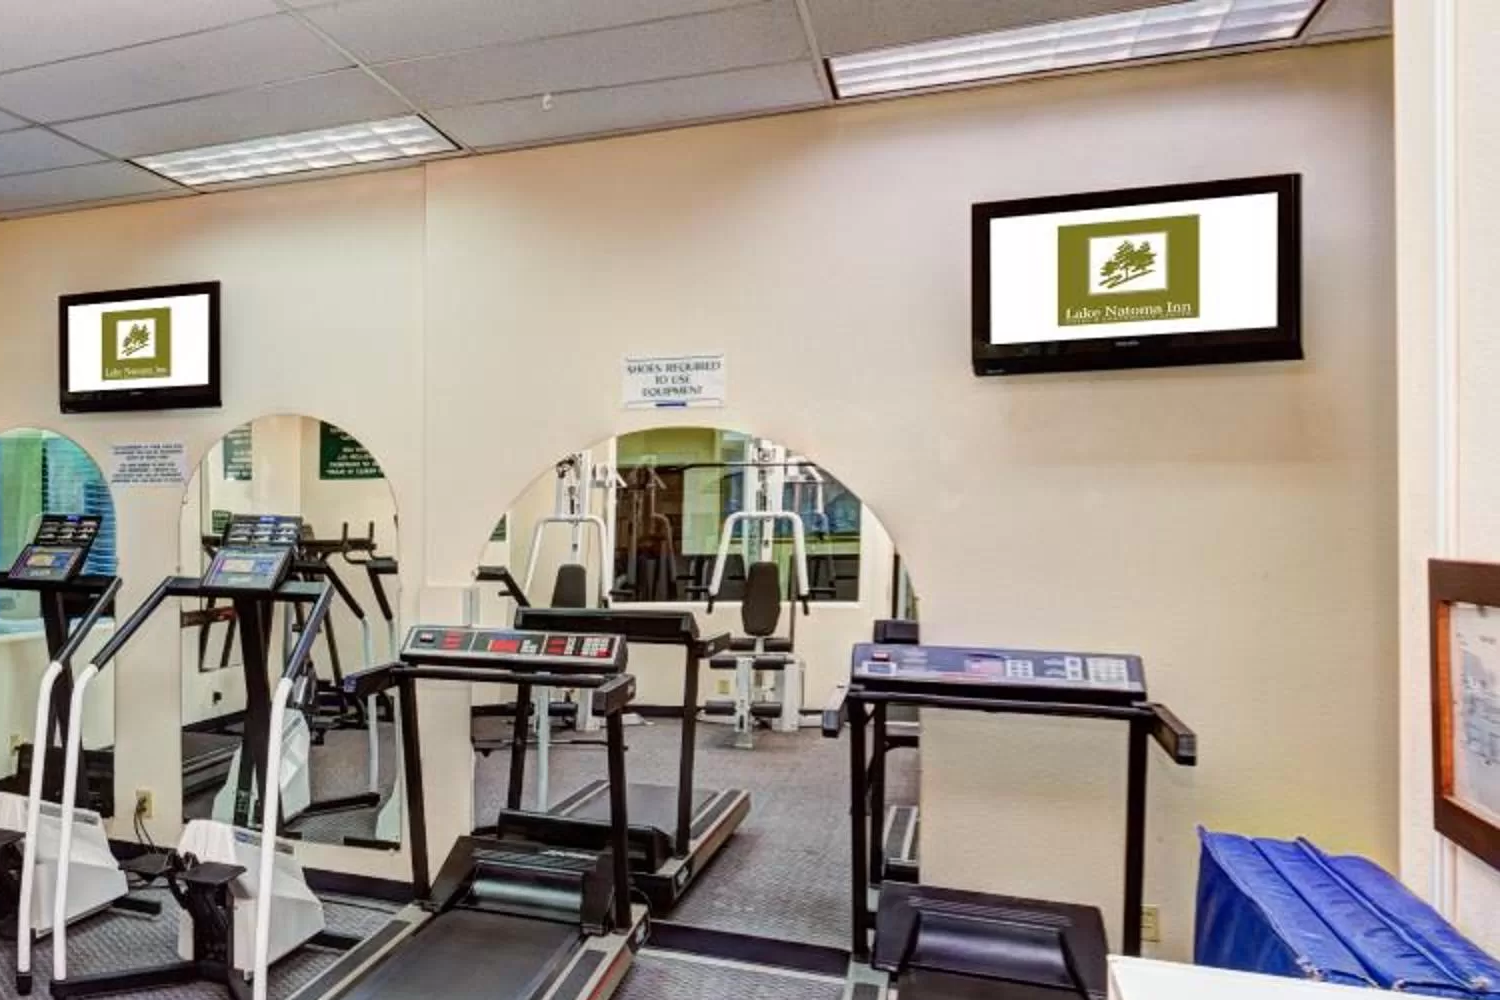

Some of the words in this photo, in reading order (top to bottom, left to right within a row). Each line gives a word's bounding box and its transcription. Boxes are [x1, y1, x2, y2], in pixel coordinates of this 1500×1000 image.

[1066, 307, 1100, 319] Lake
[1104, 304, 1164, 318] Natoma
[1166, 301, 1192, 314] Inn
[627, 363, 662, 375] SHOES
[665, 360, 721, 373] REQUIRED
[655, 375, 669, 385] TO
[671, 374, 690, 385] USE
[642, 385, 703, 397] EQUIPMENT
